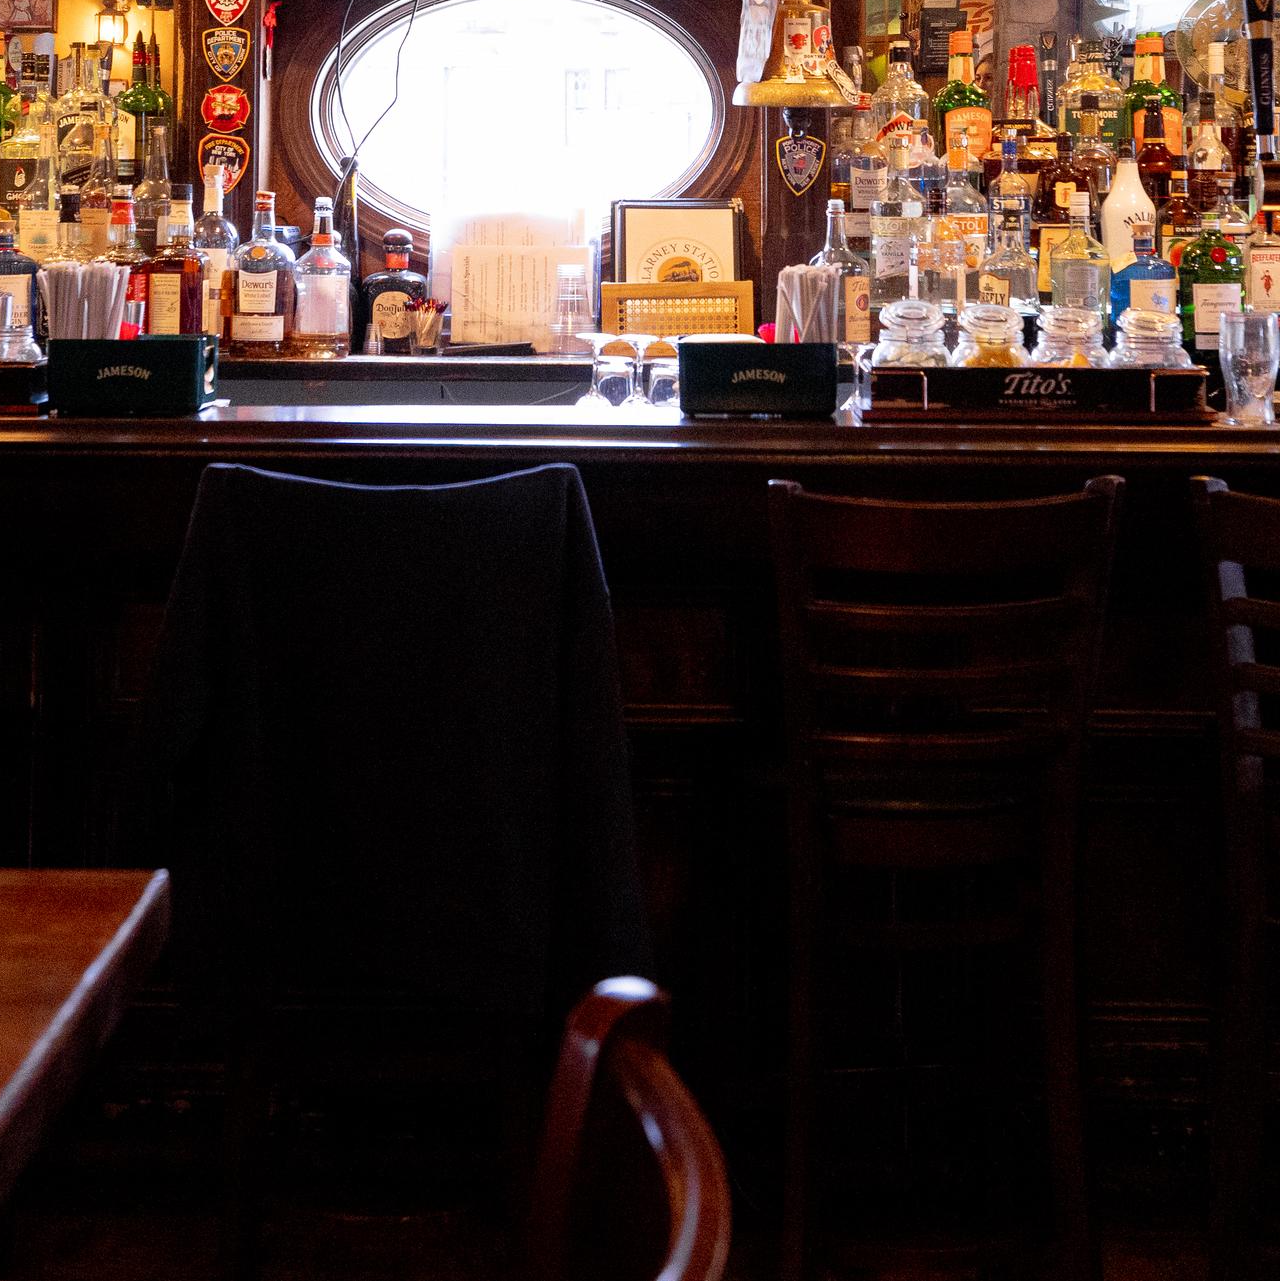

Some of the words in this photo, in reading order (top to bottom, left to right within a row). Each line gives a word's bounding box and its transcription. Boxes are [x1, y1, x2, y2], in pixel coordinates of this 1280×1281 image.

[207, 36, 246, 45] DEPARTMENT
[1260, 52, 1271, 107] GUINNESS
[950, 113, 987, 124] JAMESON
[784, 144, 817, 154] POLICE
[854, 176, 886, 186] Dewar's
[952, 220, 984, 231] STOLI
[642, 243, 681, 283] LARNEY
[683, 243, 720, 281] STATIO
[241, 279, 274, 290] Dewar's
[97, 367, 150, 382] JAMESON
[731, 370, 786, 385] JAMESON
[1004, 372, 1072, 395] Tito's
